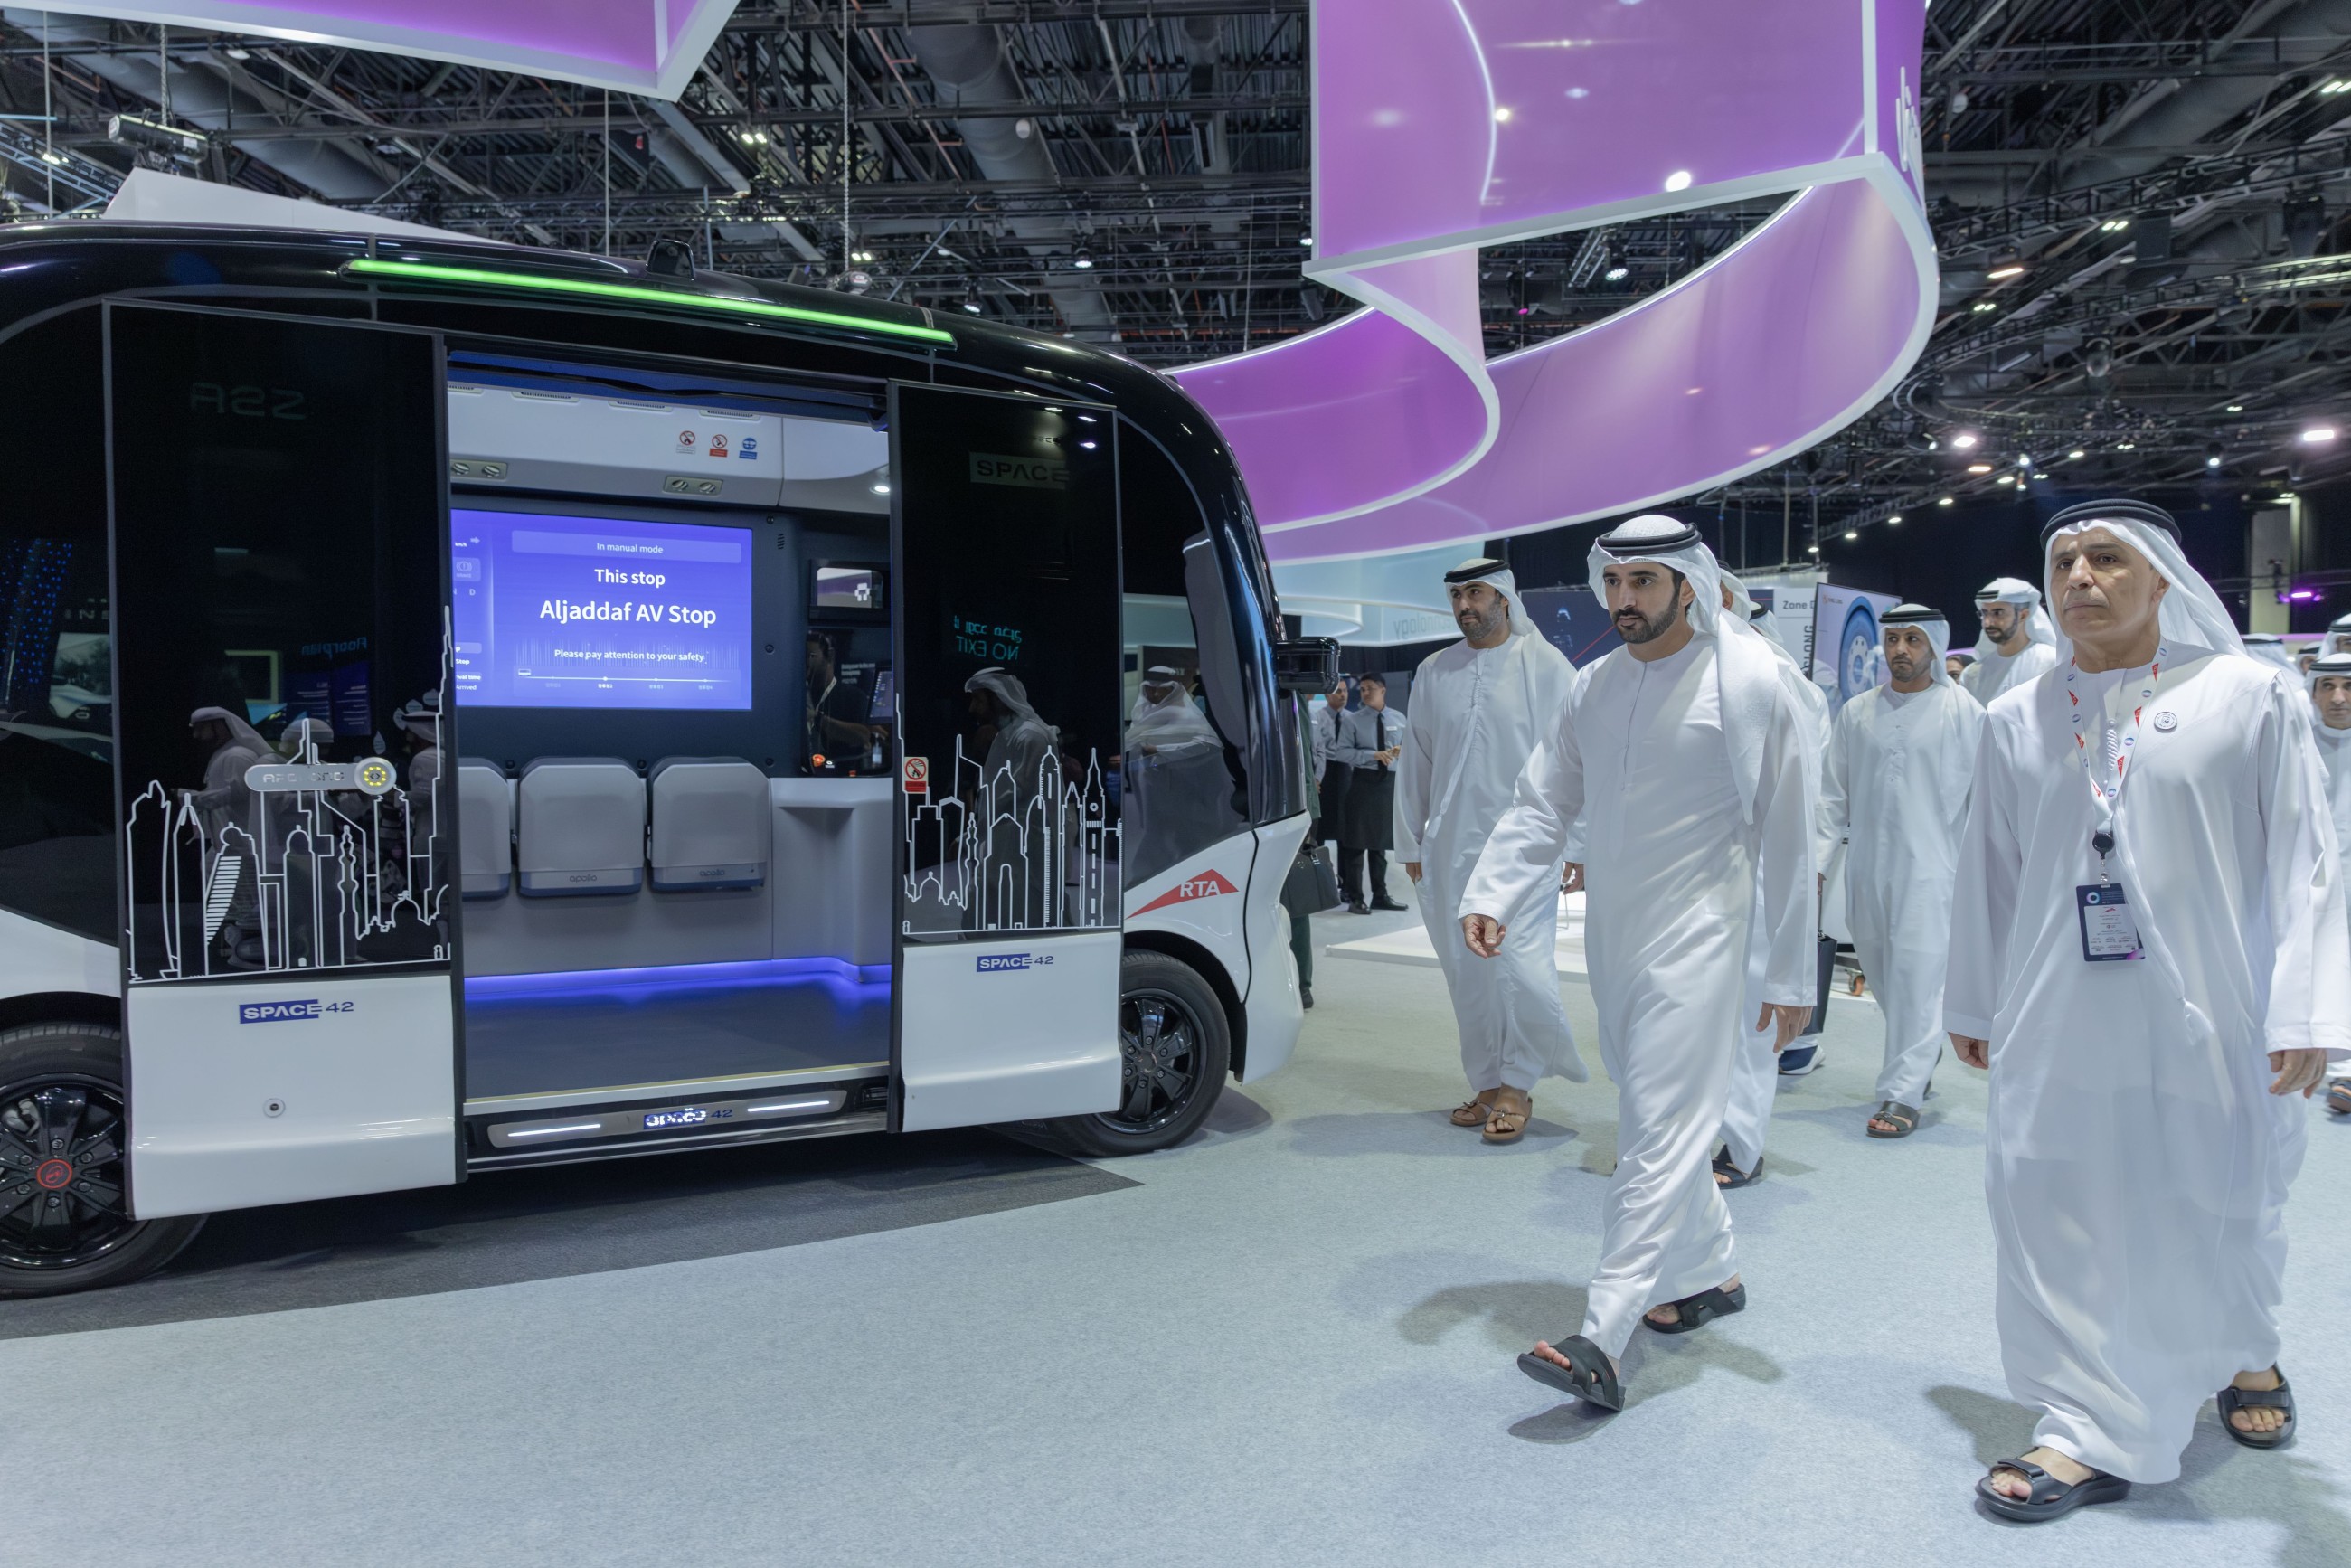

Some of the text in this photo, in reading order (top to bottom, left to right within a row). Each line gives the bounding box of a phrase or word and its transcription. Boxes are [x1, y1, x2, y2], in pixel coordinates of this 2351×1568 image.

[977, 459, 1071, 483] SPACE
[596, 543, 664, 553] In manual mode
[594, 568, 666, 588] This stop
[1782, 600, 1808, 609] Zone
[540, 599, 716, 629] Aljaddaf AV Stop
[554, 649, 583, 658] Please
[585, 651, 602, 660] pay
[604, 650, 645, 659] attention
[656, 653, 677, 662] your
[569, 874, 598, 883] apollo
[1179, 880, 1221, 898] RTA
[978, 955, 1054, 969] SPACE 42
[242, 1001, 354, 1020] SPACE 42
[711, 1109, 733, 1119] 42
